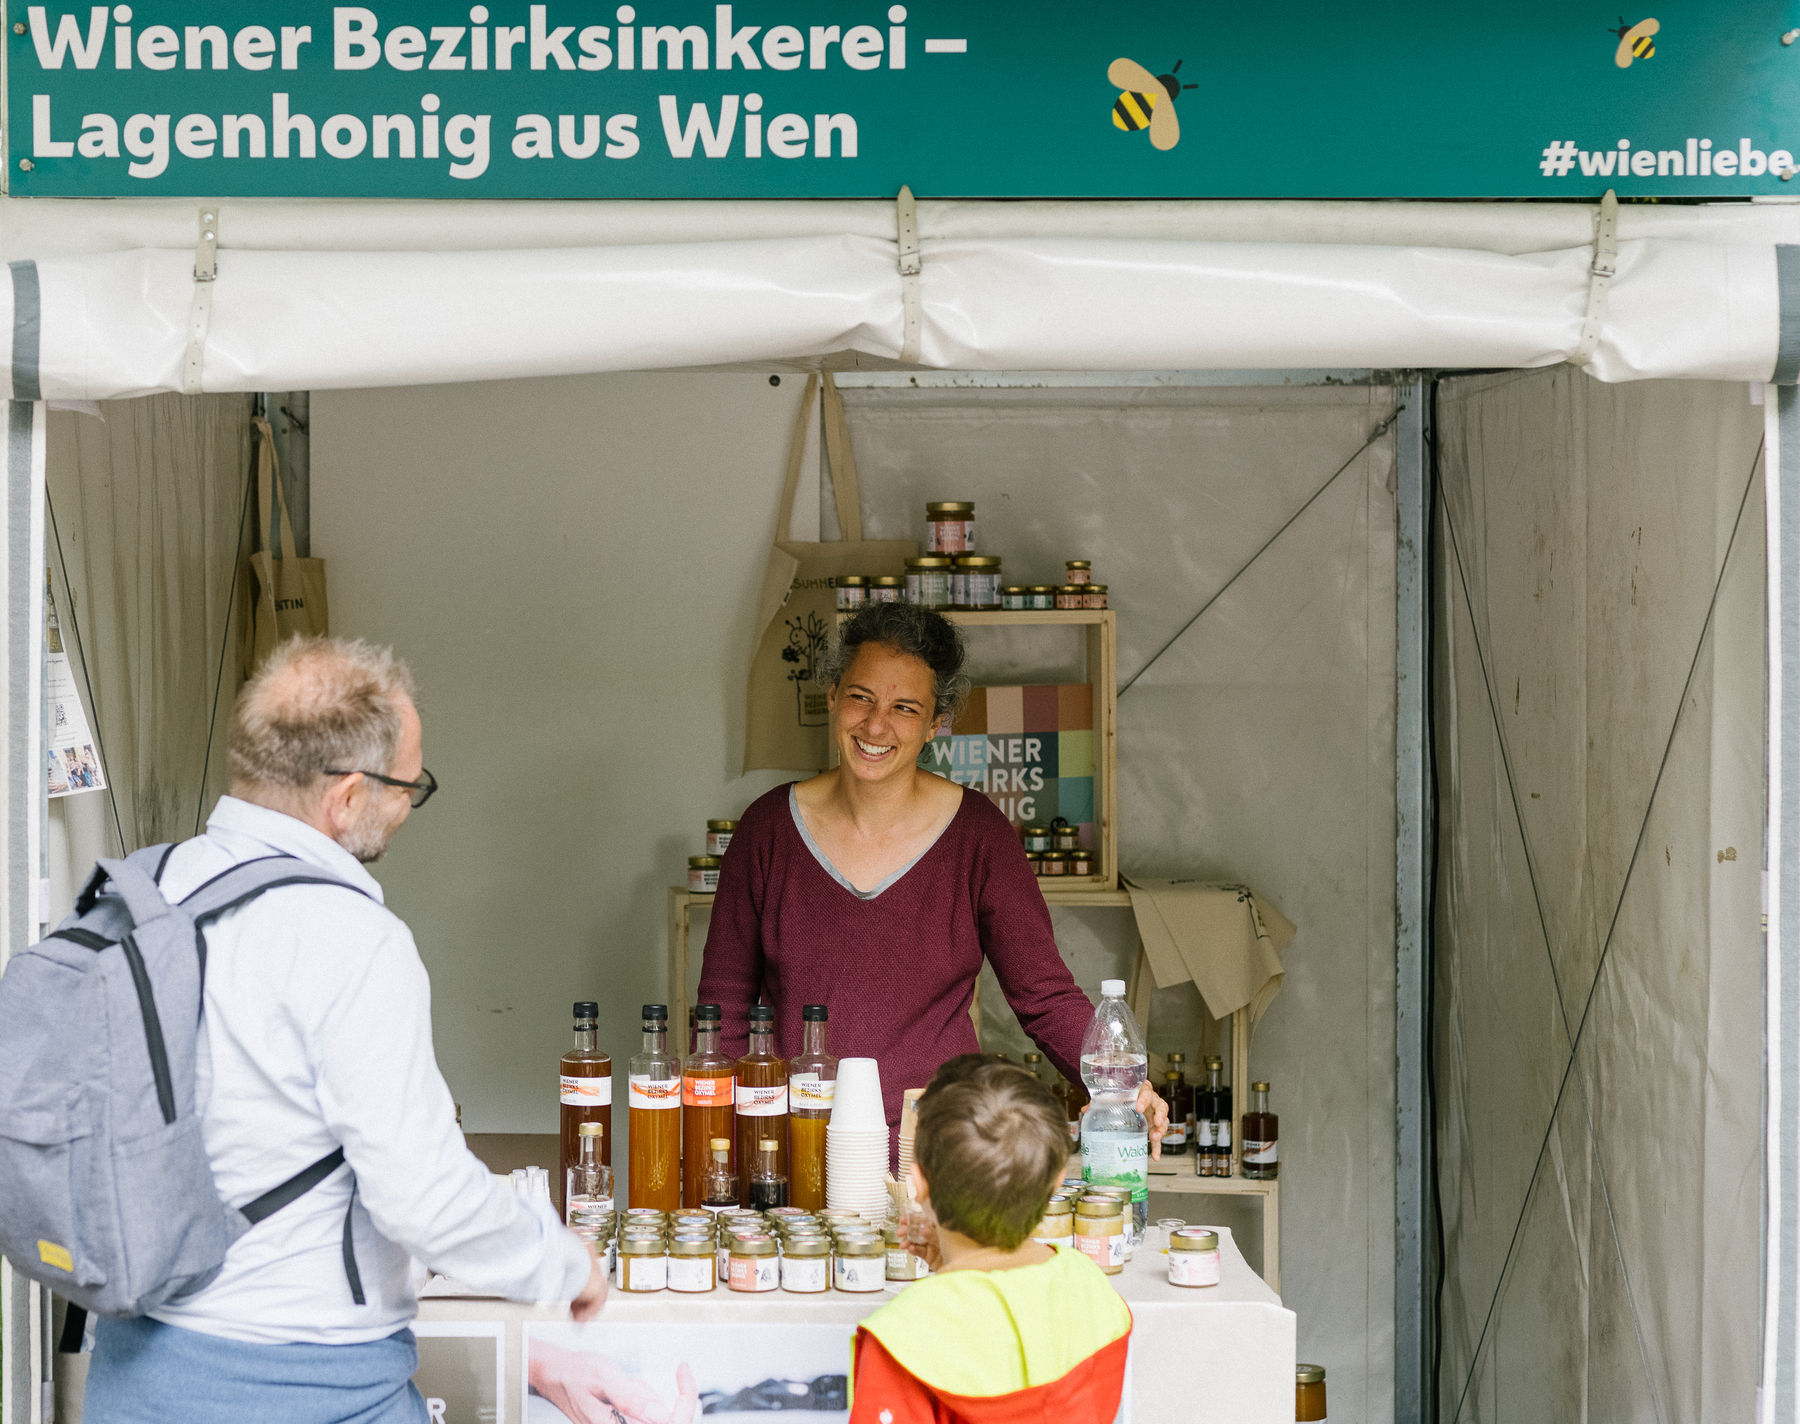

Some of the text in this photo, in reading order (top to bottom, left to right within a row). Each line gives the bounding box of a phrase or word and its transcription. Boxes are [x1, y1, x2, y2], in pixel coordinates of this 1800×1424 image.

[28, 5, 312, 71] Wiener
[333, 5, 907, 71] Bezirksimkerei
[28, 92, 858, 180] Lagenhonig aus Wien
[1539, 137, 1794, 177] #wienliebe
[931, 737, 1042, 767] WIENER
